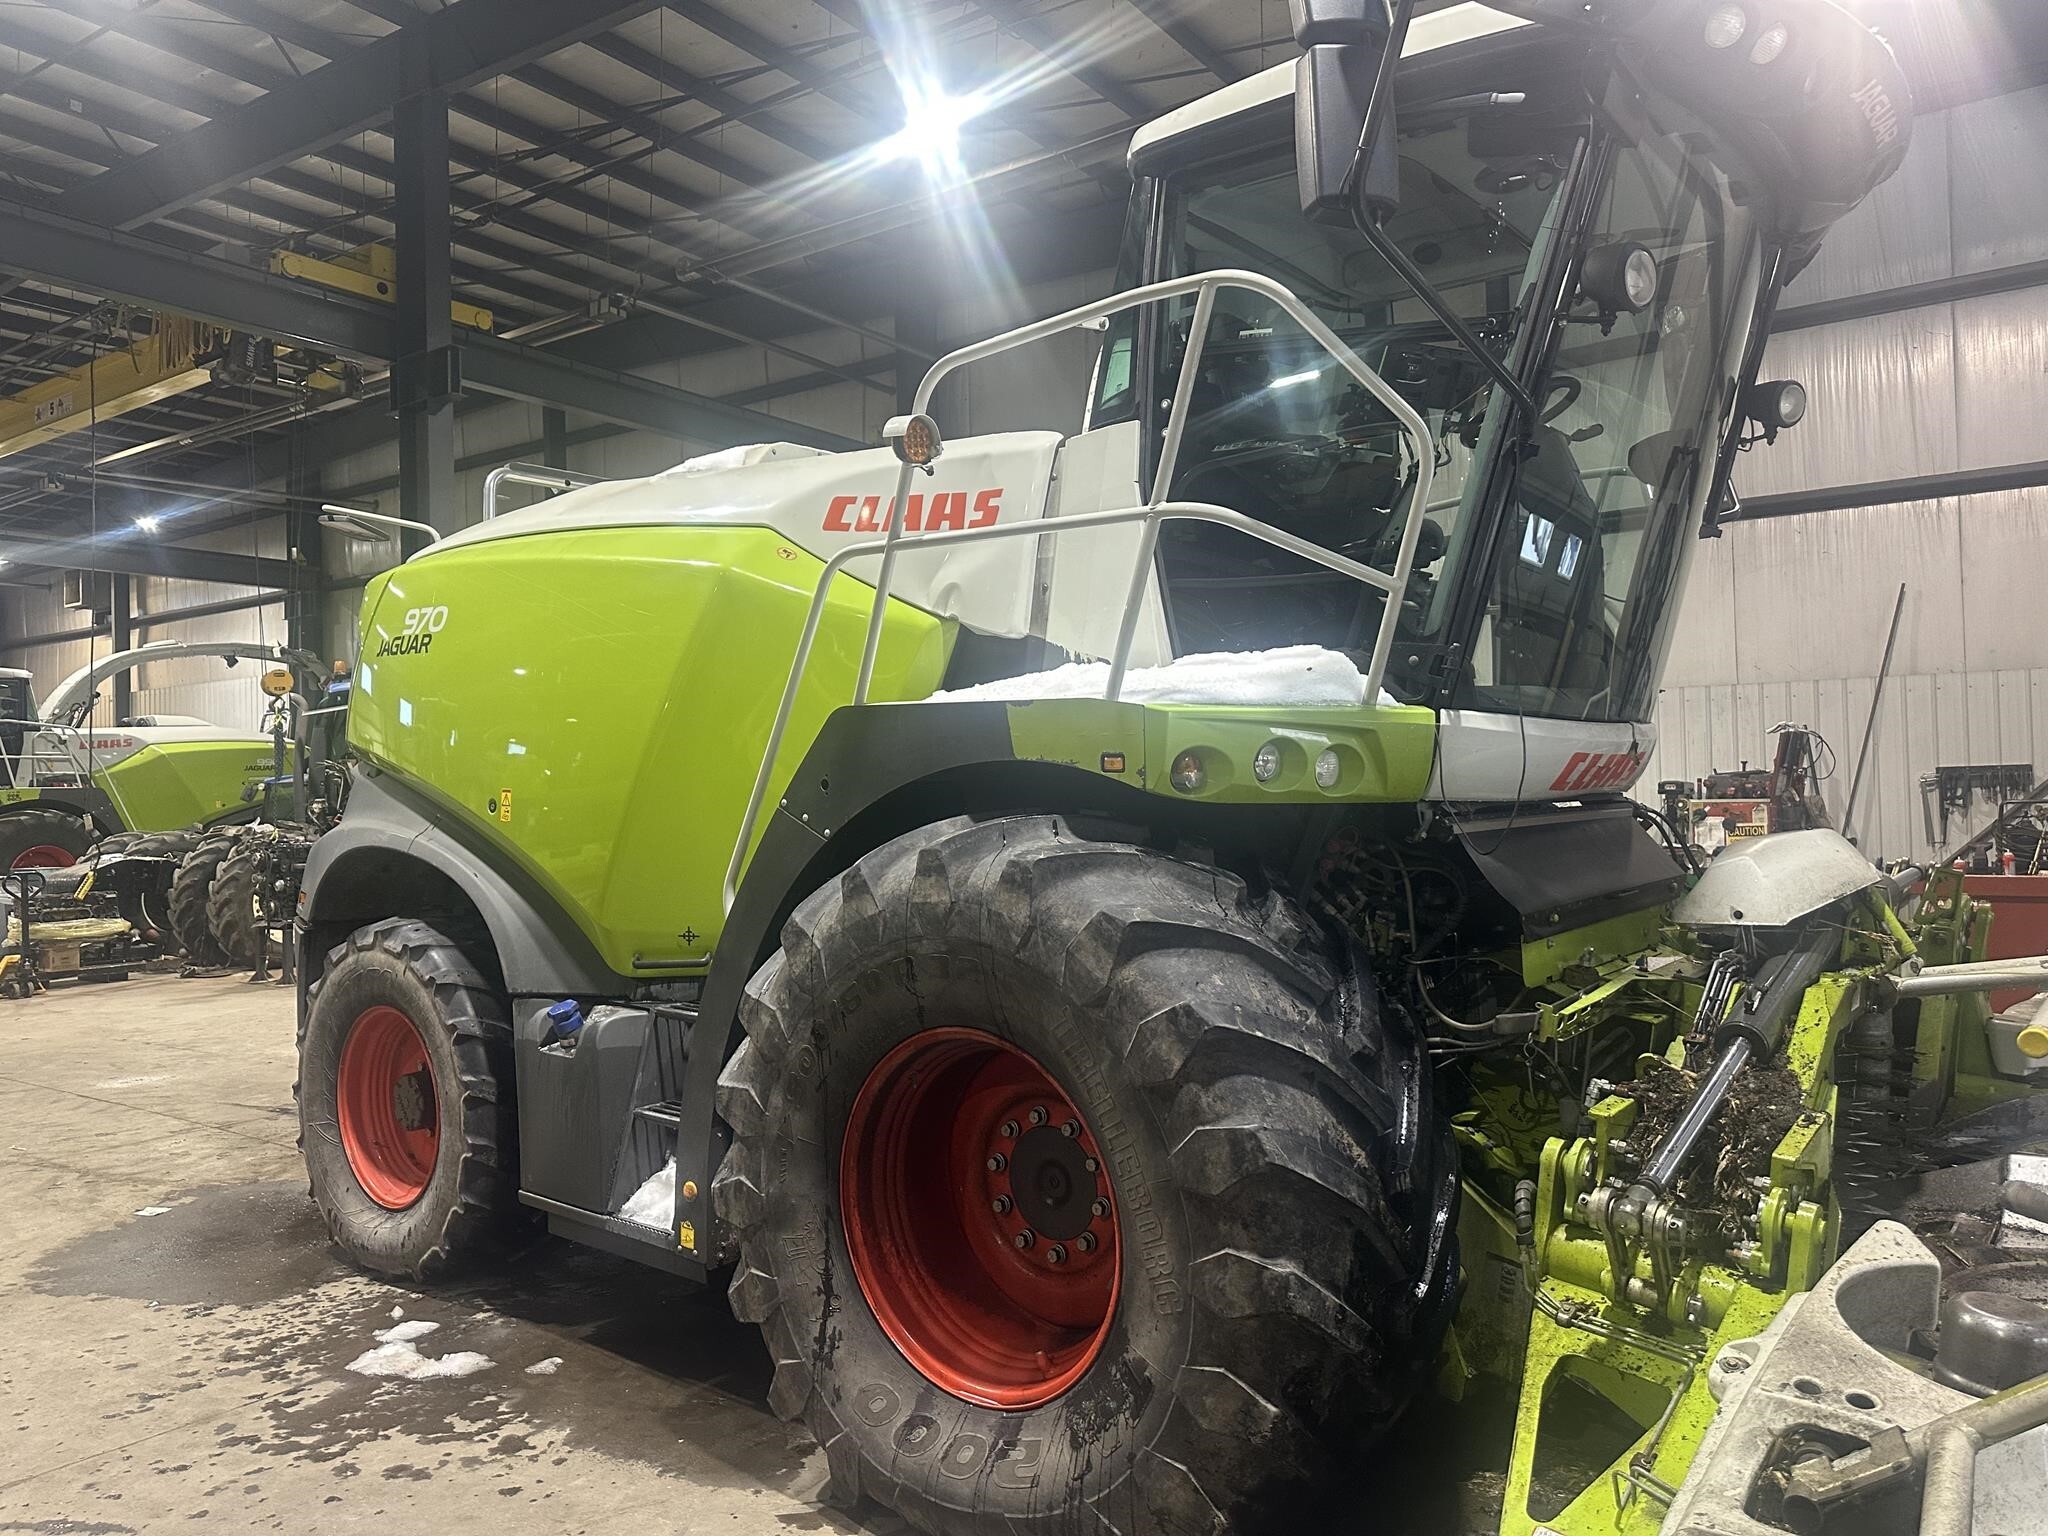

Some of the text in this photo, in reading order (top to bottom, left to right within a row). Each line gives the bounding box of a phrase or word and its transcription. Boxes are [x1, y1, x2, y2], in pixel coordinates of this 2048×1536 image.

[1849, 79, 1898, 149] JAGUAR
[246, 334, 256, 368] SHAW-B
[822, 488, 1004, 531] CLAAS
[402, 605, 449, 635] 970
[376, 633, 432, 657] JAGUAR
[851, 1383, 1043, 1489] 2000
